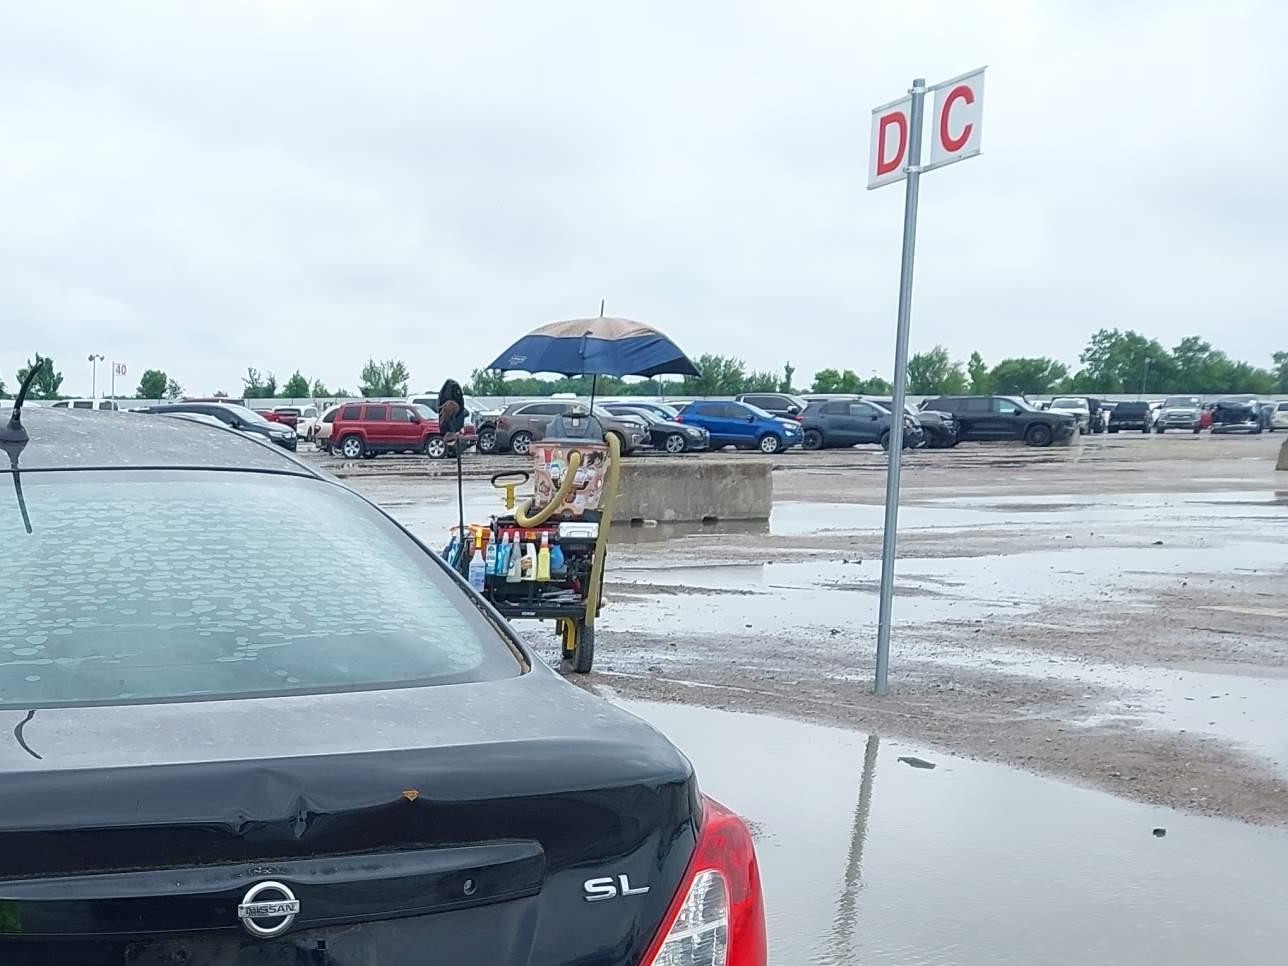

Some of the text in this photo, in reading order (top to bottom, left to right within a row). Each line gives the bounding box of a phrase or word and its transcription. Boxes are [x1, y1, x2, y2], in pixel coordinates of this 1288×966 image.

[940, 85, 975, 152] C
[877, 111, 908, 176] D
[115, 363, 127, 376] 40
[584, 874, 650, 902] SL
[245, 903, 295, 916] NISSAN
